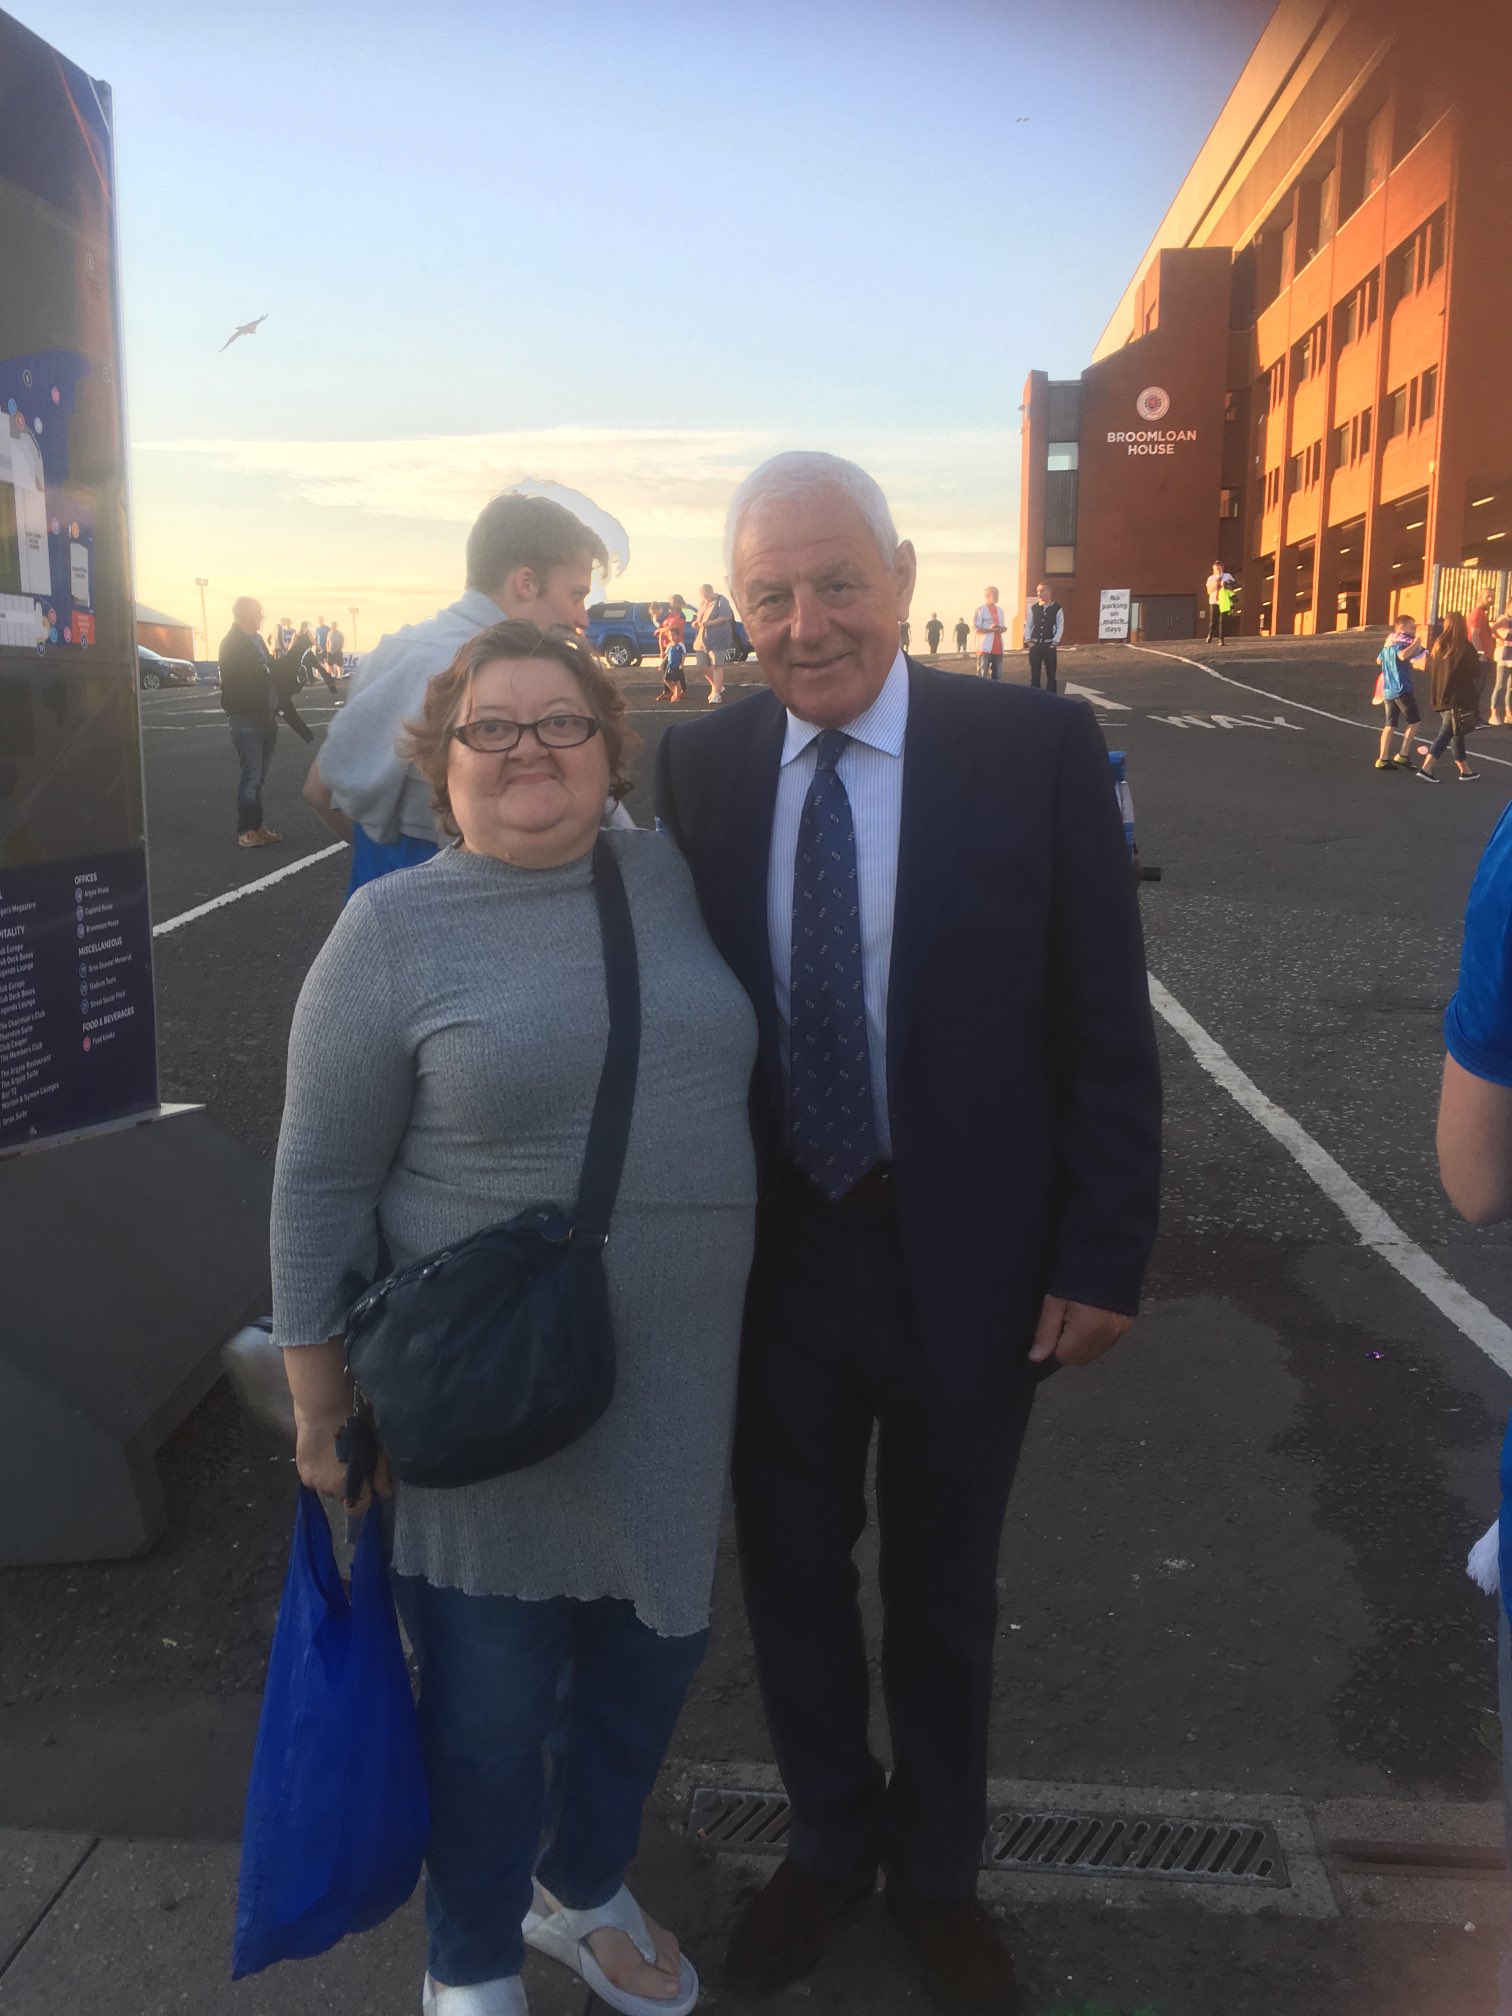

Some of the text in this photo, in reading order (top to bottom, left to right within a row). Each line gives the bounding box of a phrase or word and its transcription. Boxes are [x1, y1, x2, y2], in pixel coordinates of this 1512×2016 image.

[1107, 430, 1197, 443] BROOMLOAN
[1127, 443, 1175, 456] HOUSE
[1105, 625, 1121, 633] days
[1146, 715, 1305, 730] WAY
[74, 872, 98, 885] OFFICES
[78, 936, 123, 957] MISCELLANEOUS
[34, 1009, 46, 1020] Club
[82, 1019, 99, 1033] FOOD
[99, 1016, 104, 1026] &
[103, 1005, 135, 1025] BEVERAGES
